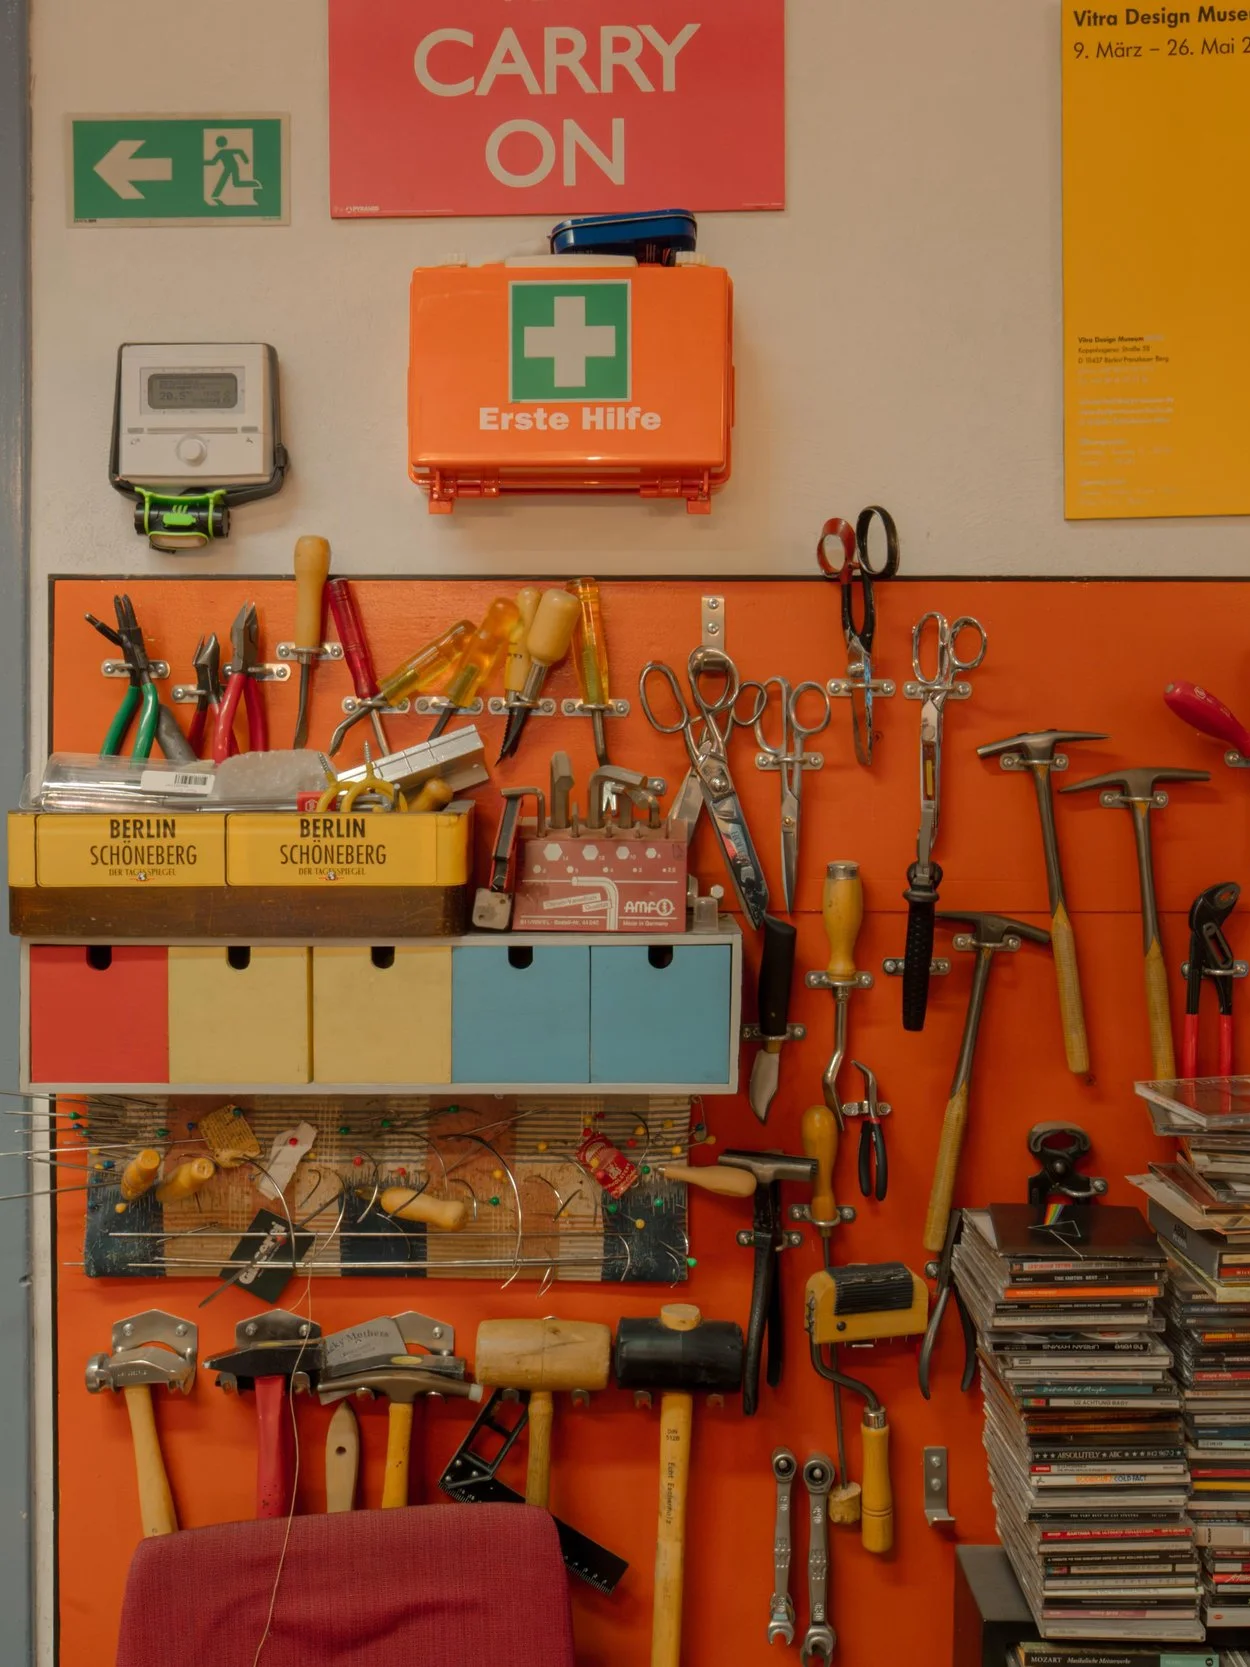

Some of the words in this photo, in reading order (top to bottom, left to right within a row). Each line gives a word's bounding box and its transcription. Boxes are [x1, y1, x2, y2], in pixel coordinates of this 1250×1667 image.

[1073, 10, 1118, 26] Vitra
[1125, 8, 1190, 28] Design
[1073, 42, 1089, 59] 9.
[1096, 41, 1142, 59] März
[1167, 39, 1194, 56] 26.
[1201, 37, 1235, 55] Mai
[414, 23, 701, 97] CARRY
[485, 117, 626, 188] ON
[478, 406, 570, 432] Erste
[581, 406, 662, 432] Hilfe
[110, 819, 176, 839] BERLIN
[300, 818, 366, 838] BERLIN
[90, 841, 197, 866] SCHÖNEBERG
[280, 840, 386, 865] SCHÖNEBERG
[109, 868, 123, 876] DER
[624, 901, 656, 913] AMF
[1057, 1450, 1101, 1459] ABSOLUTELY
[1109, 1450, 1122, 1458] ABC
[1031, 1656, 1063, 1664] MOZART
